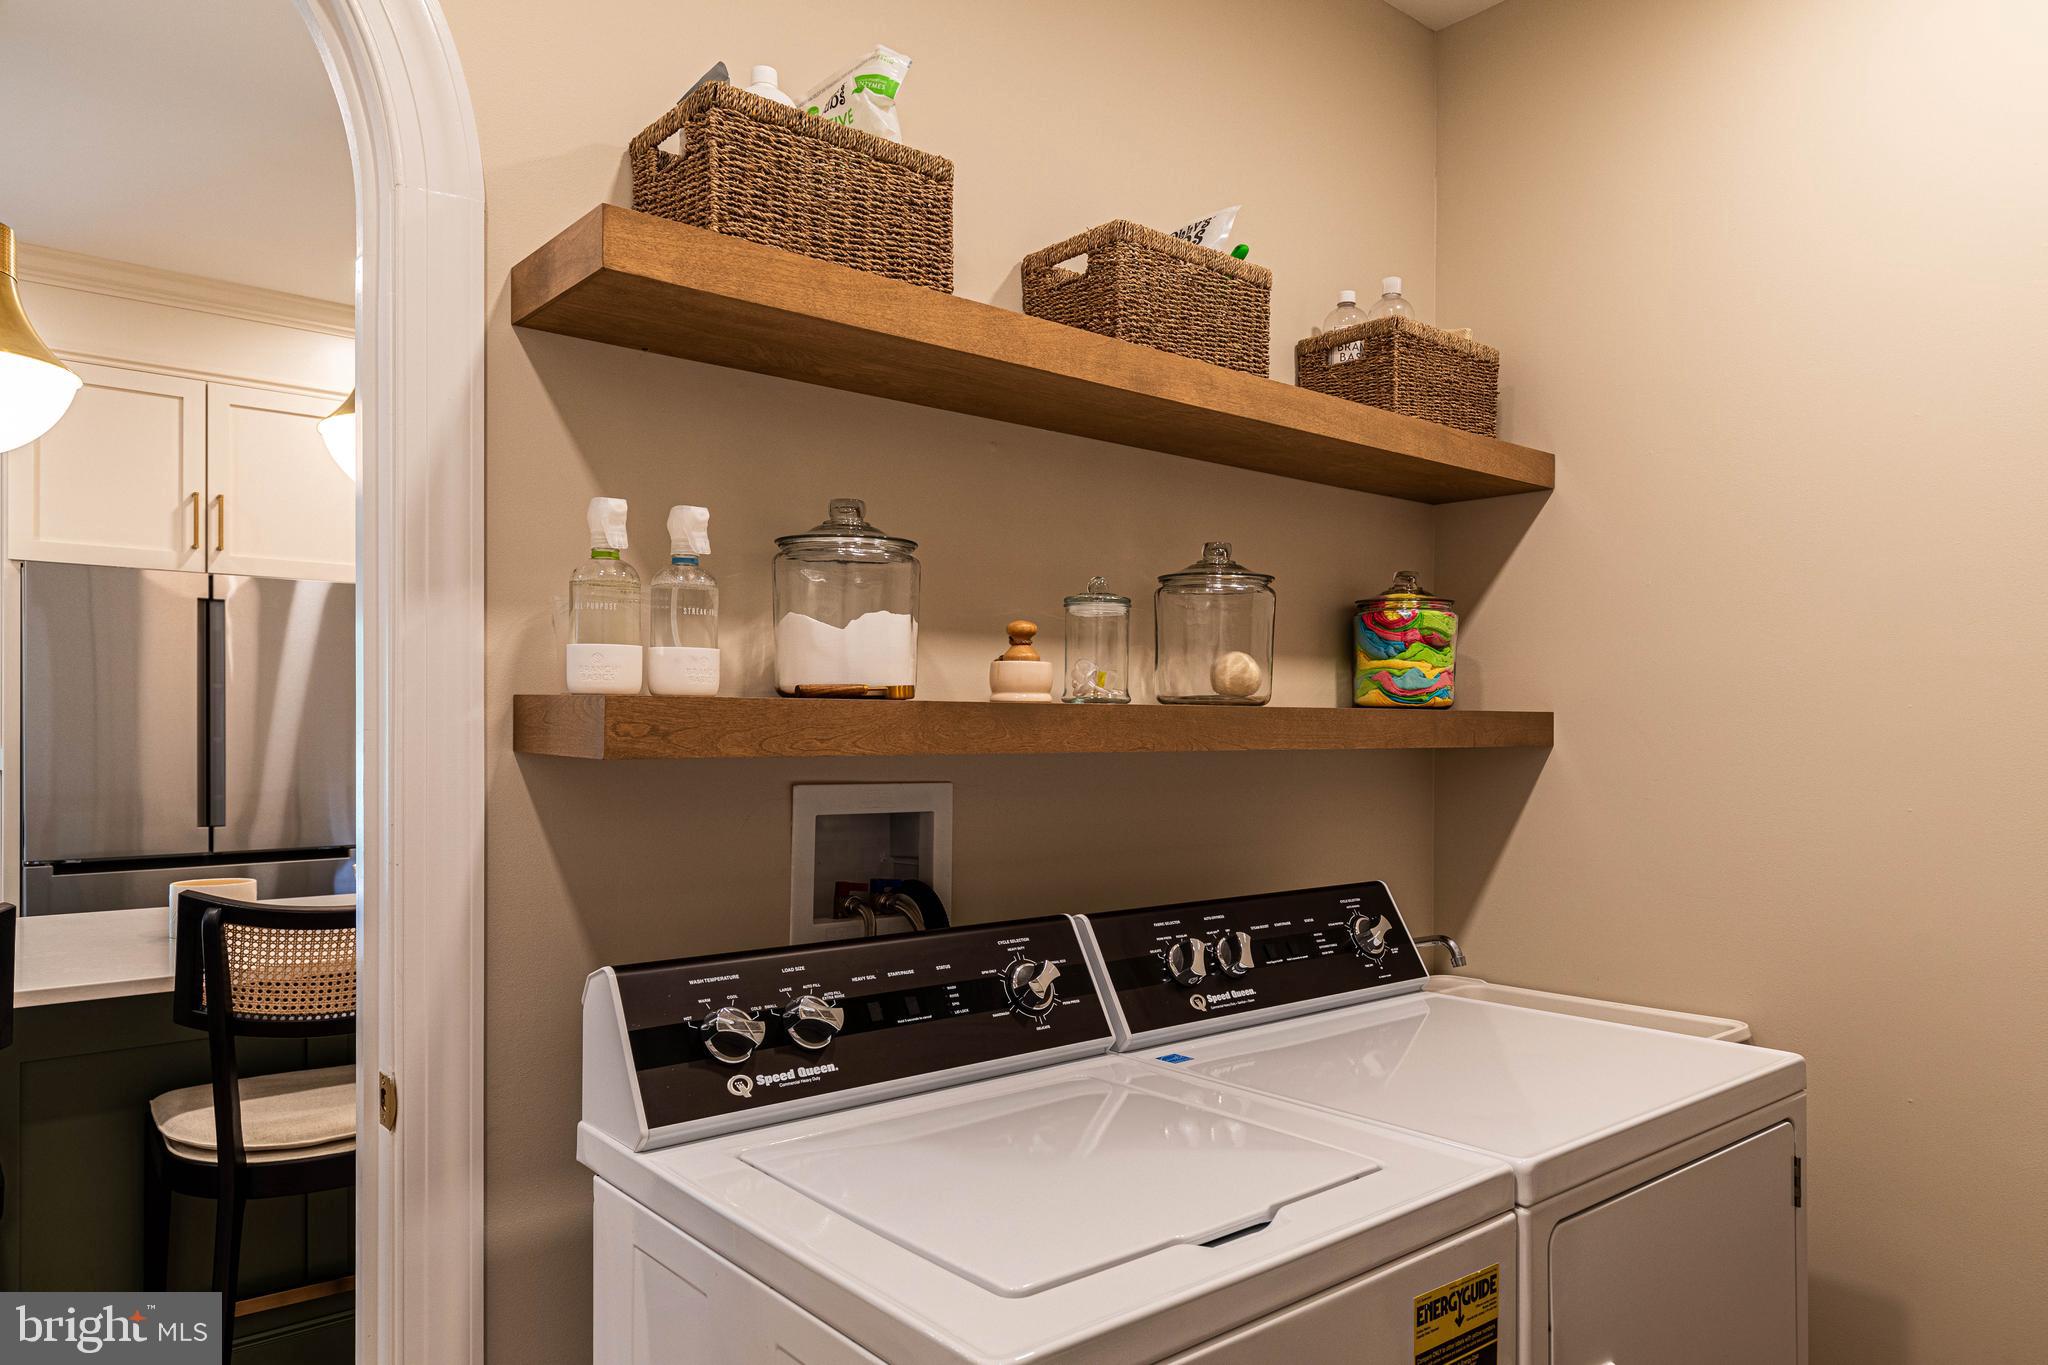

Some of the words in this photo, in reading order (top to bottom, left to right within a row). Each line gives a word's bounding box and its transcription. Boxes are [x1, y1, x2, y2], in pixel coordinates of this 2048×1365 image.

[704, 973, 740, 983] TEMPERATURE
[1206, 991, 1231, 1004] Speed
[755, 1069, 796, 1087] Speed
[797, 1063, 839, 1078] Queen.
[1416, 1273, 1498, 1328] ENERGYGUIDE
